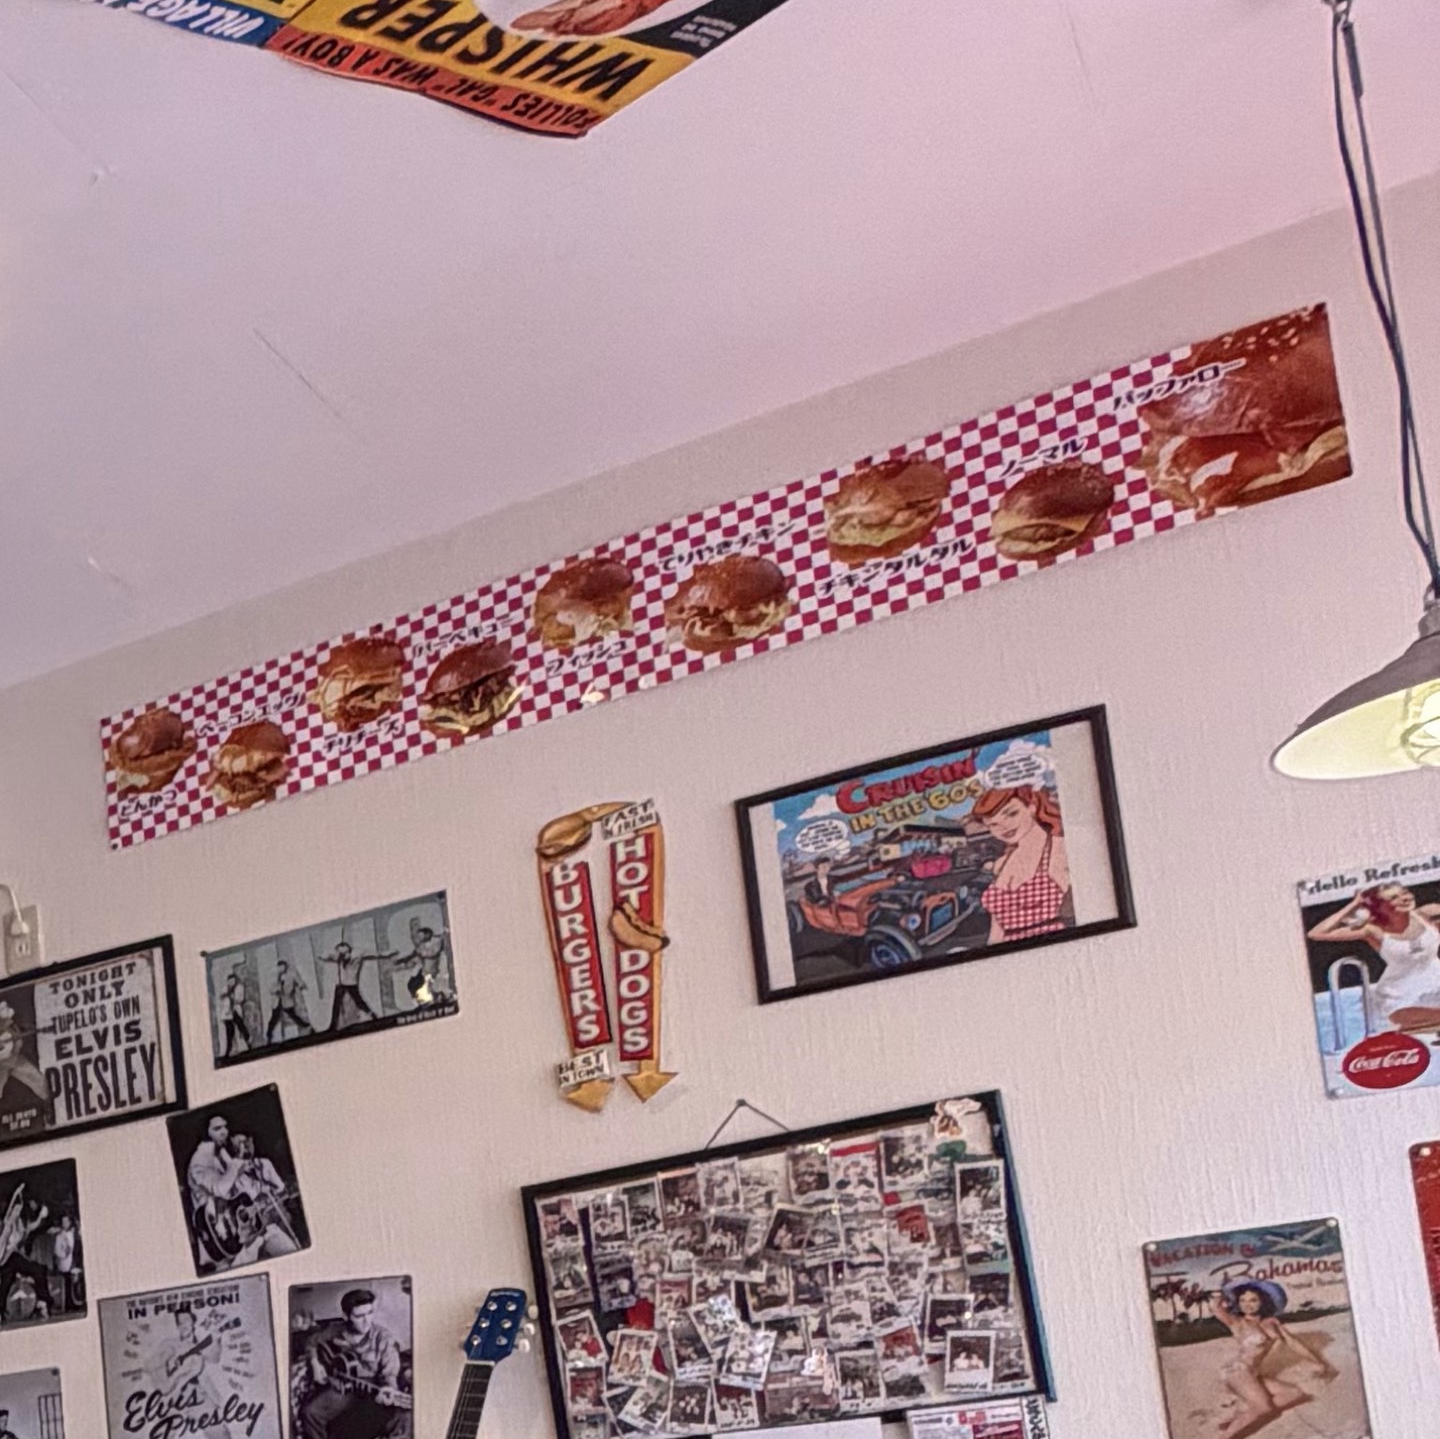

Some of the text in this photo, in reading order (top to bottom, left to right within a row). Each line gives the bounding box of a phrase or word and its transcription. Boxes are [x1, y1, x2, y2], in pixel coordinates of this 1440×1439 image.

[280, 29, 350, 70] BOY!
[354, 47, 376, 67] A
[380, 51, 439, 87] WAS
[1112, 357, 1246, 415] バッファロー
[998, 436, 1087, 478] ノーマル
[815, 537, 977, 598] チキンタルタル
[603, 802, 653, 826] FAST
[848, 799, 925, 835] IN THE
[616, 835, 649, 911] HOT
[551, 862, 603, 1043] BURGERS
[48, 961, 137, 995] TONIGHT
[64, 980, 126, 1009] ONLY
[50, 994, 141, 1035] TUPELO'S OWN
[618, 949, 651, 1052] DOGS
[54, 1018, 143, 1061] ELVIS
[558, 1050, 603, 1076] BEST
[572, 1064, 605, 1082] TOWN
[1348, 1047, 1421, 1075] Coca-Cola
[45, 1040, 156, 1127] PRESLEY
[1149, 1243, 1234, 1268] VACATION
[1209, 1256, 1345, 1284] Bahamas
[126, 1307, 148, 1320] IN
[122, 1387, 205, 1433] Elvis
